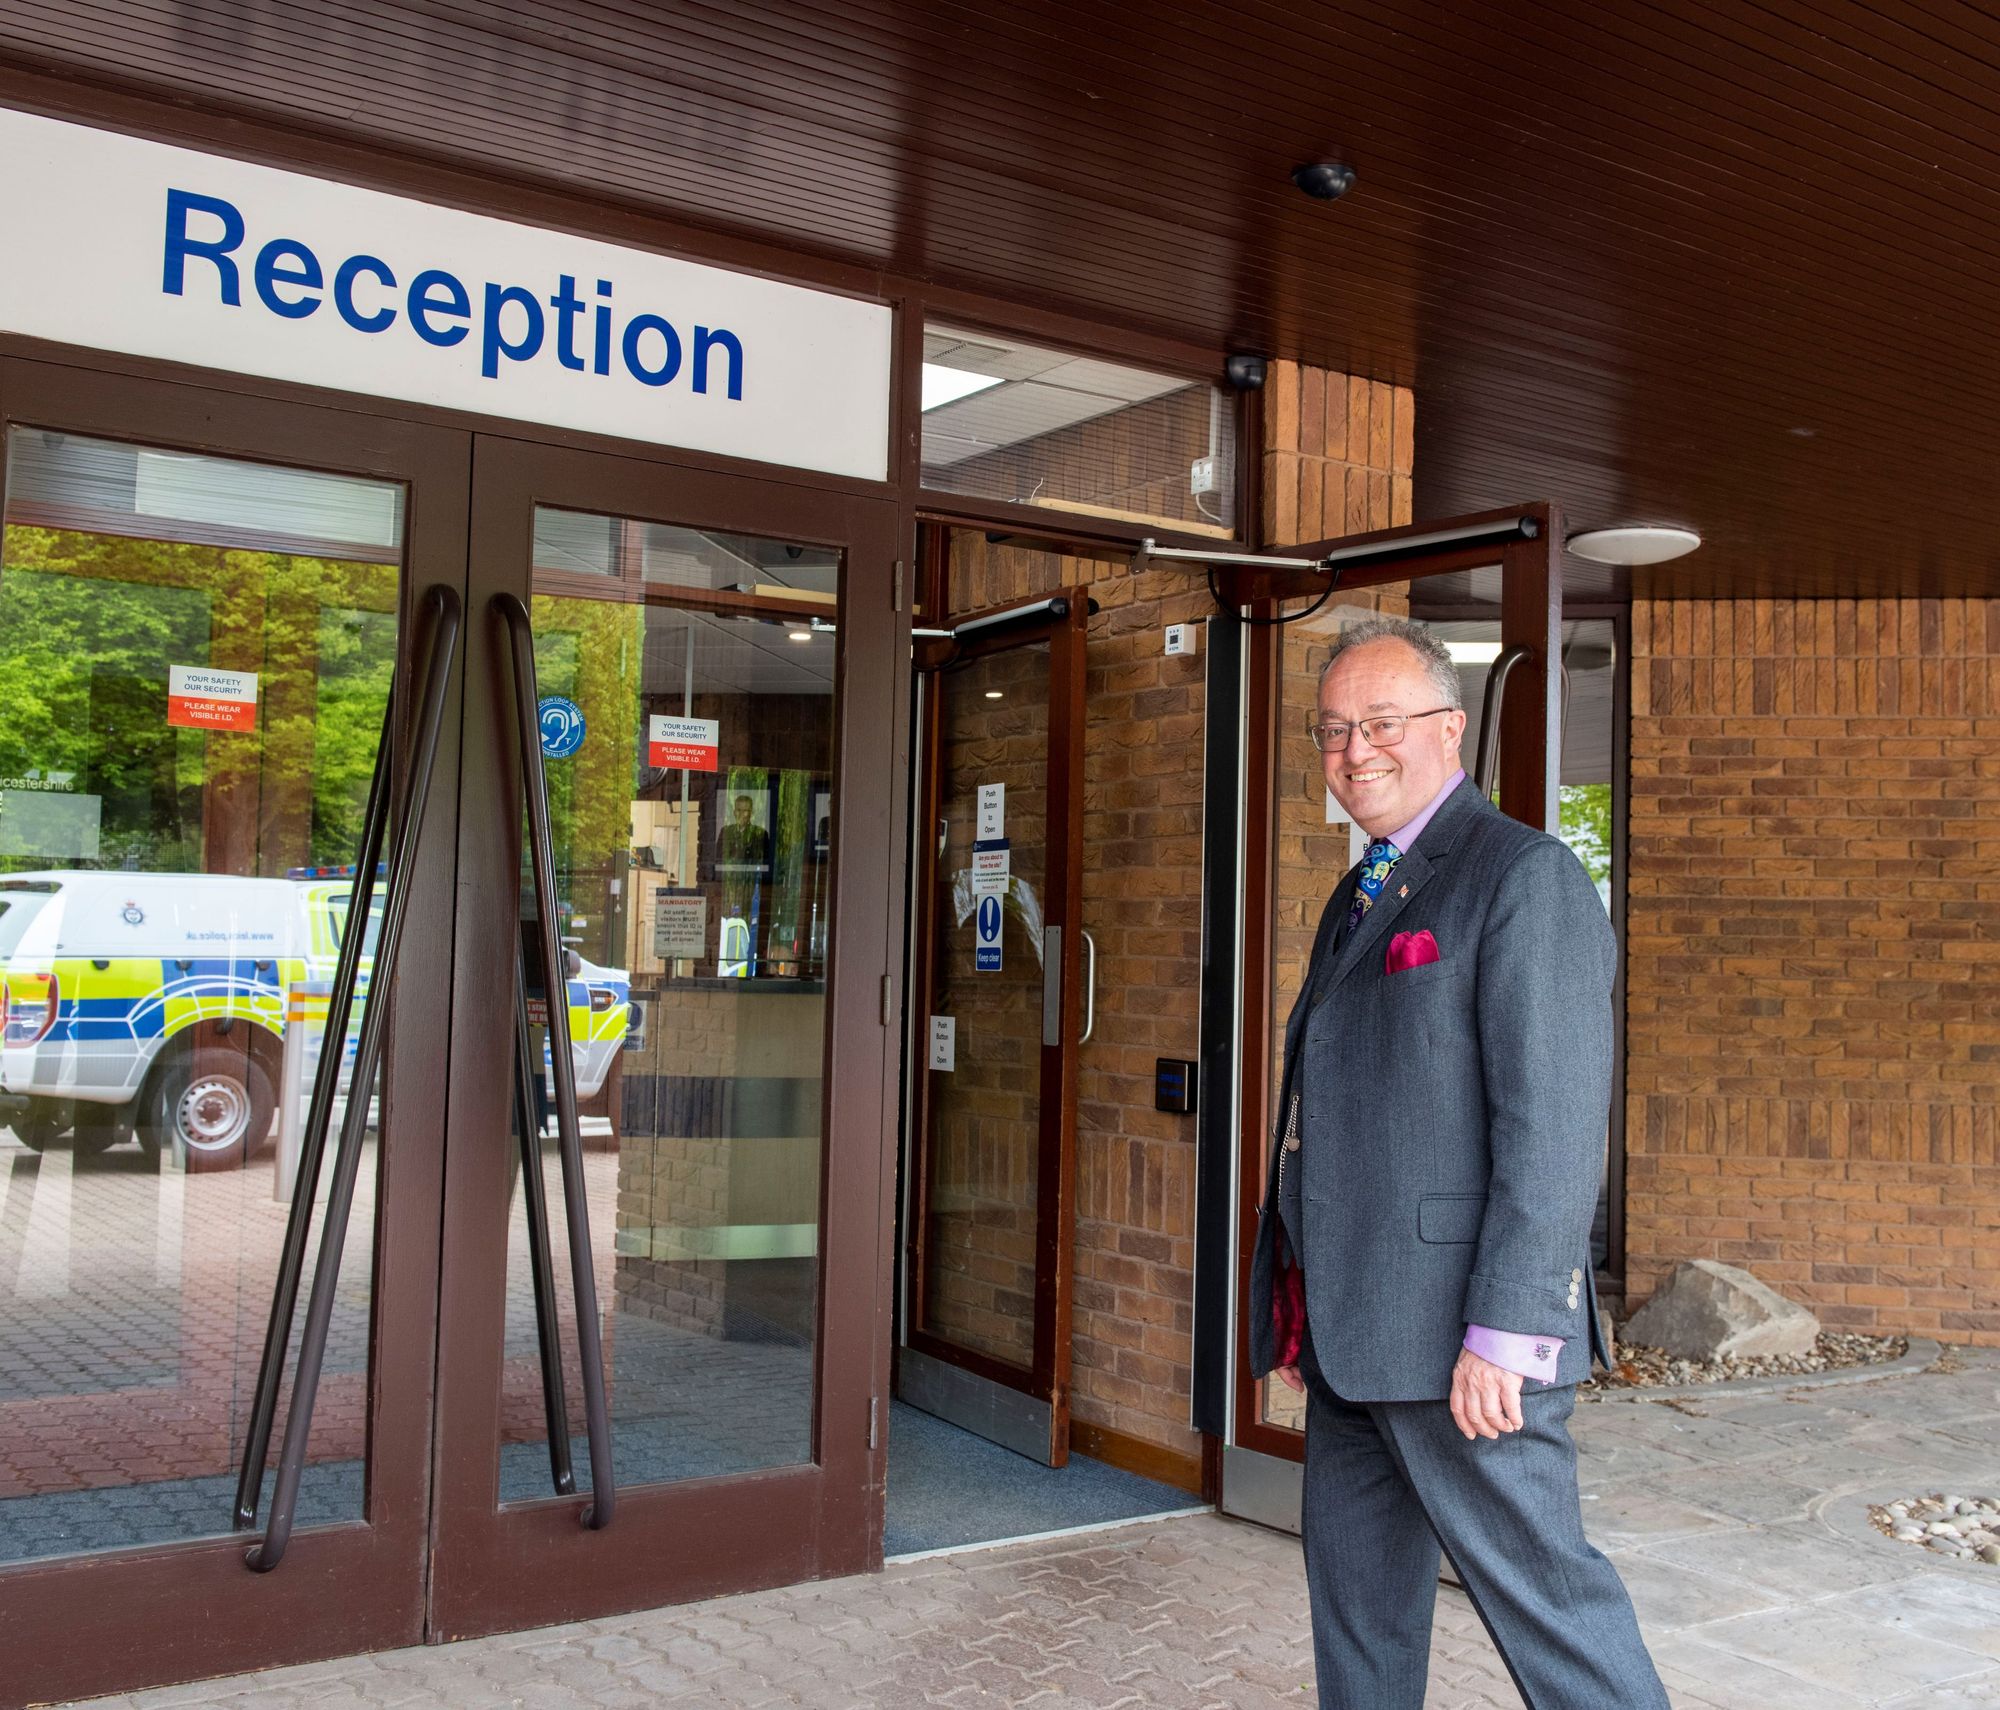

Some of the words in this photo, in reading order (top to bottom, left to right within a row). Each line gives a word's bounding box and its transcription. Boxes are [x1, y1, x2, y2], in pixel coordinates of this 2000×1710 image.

[162, 188, 744, 401] Reception
[186, 674, 209, 683] YOUR
[211, 677, 241, 686] SAFETY
[184, 683, 202, 691] OUR
[203, 685, 243, 695] SECURITY
[184, 701, 215, 711] PLEASE
[217, 704, 241, 713] WEAR
[538, 697, 554, 707] CTION
[568, 702, 584, 722] SYSTEM
[190, 711, 221, 721] VISIBLE
[222, 714, 234, 722] I.D.
[663, 722, 681, 730] YOUR
[682, 724, 706, 732] SAFETY
[676, 731, 707, 740] SECURITY
[564, 737, 571, 745] T
[543, 750, 570, 758] NSTALLED
[661, 746, 686, 755] PLEASE
[666, 754, 690, 763] VISIBLE
[984, 826, 996, 834] Open
[978, 953, 989, 964] Keep
[989, 953, 1000, 962] clear
[937, 1021, 948, 1029] Push
[936, 1032, 949, 1040] Button
[936, 1056, 947, 1064] Open
